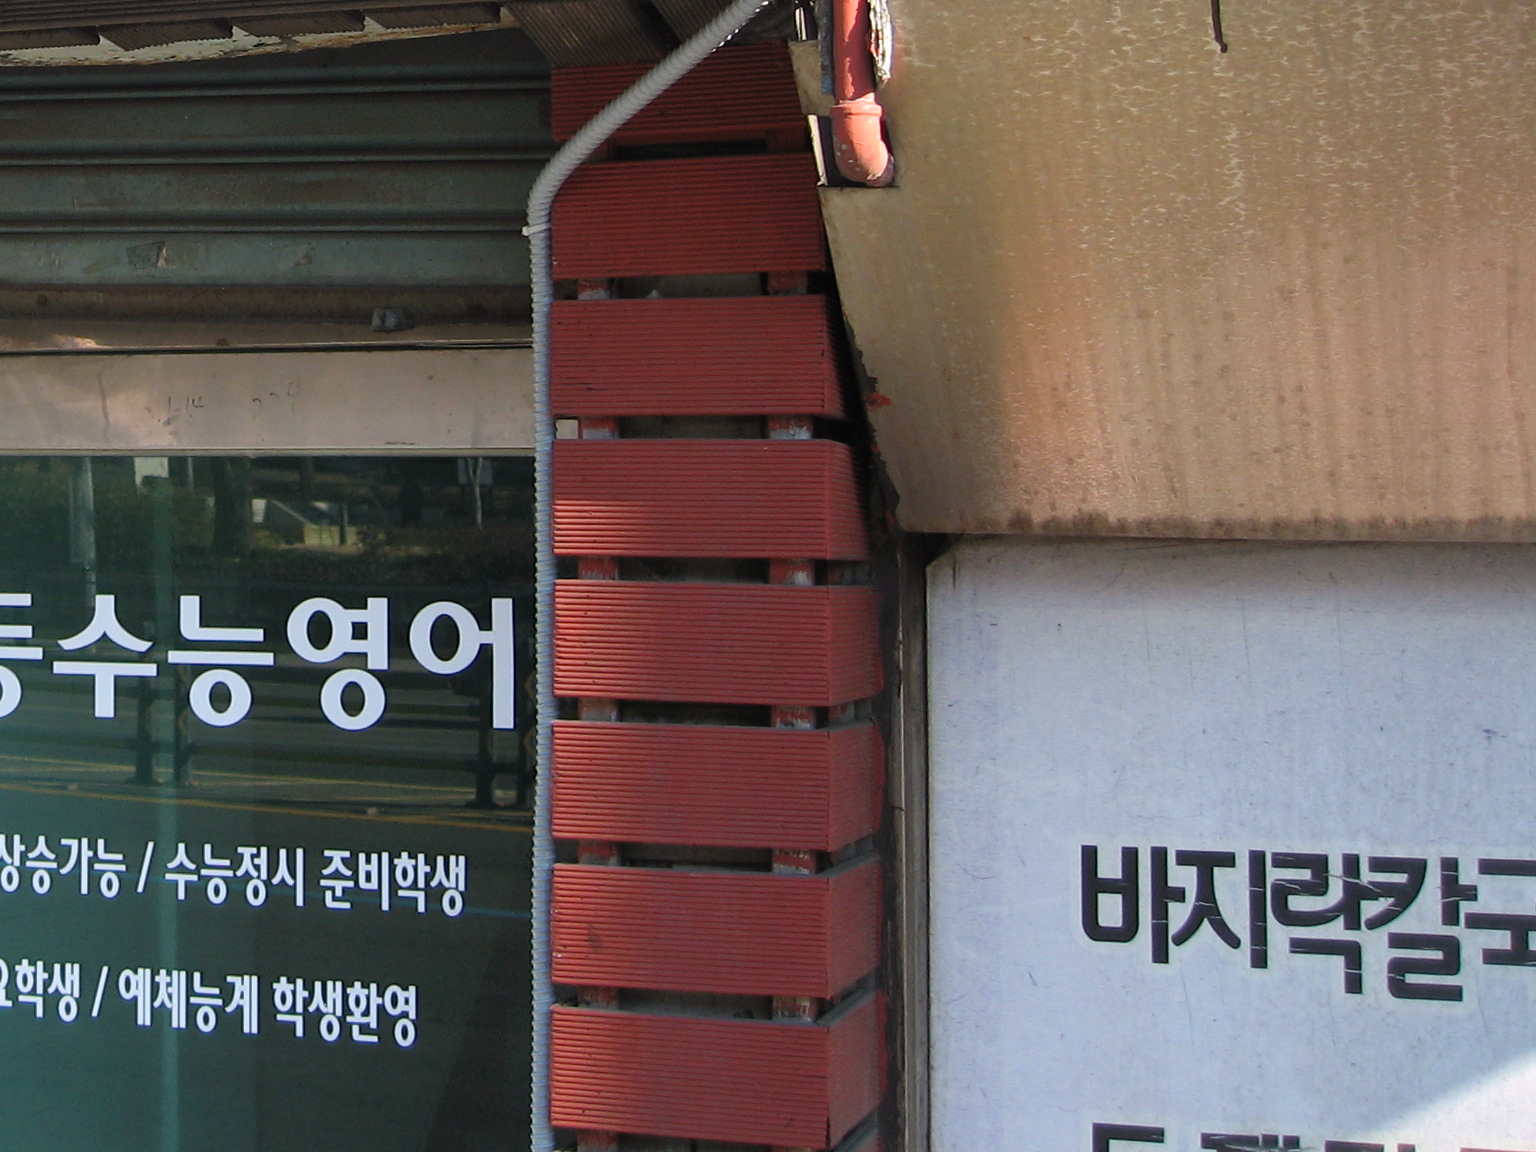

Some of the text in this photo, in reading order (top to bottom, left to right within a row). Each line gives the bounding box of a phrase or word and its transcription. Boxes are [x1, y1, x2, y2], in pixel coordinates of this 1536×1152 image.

[164, 842, 304, 907] 수능정시
[319, 849, 466, 917] 준비학생
[118, 967, 258, 1034] 예체능계
[272, 976, 417, 1047] 학생환영
